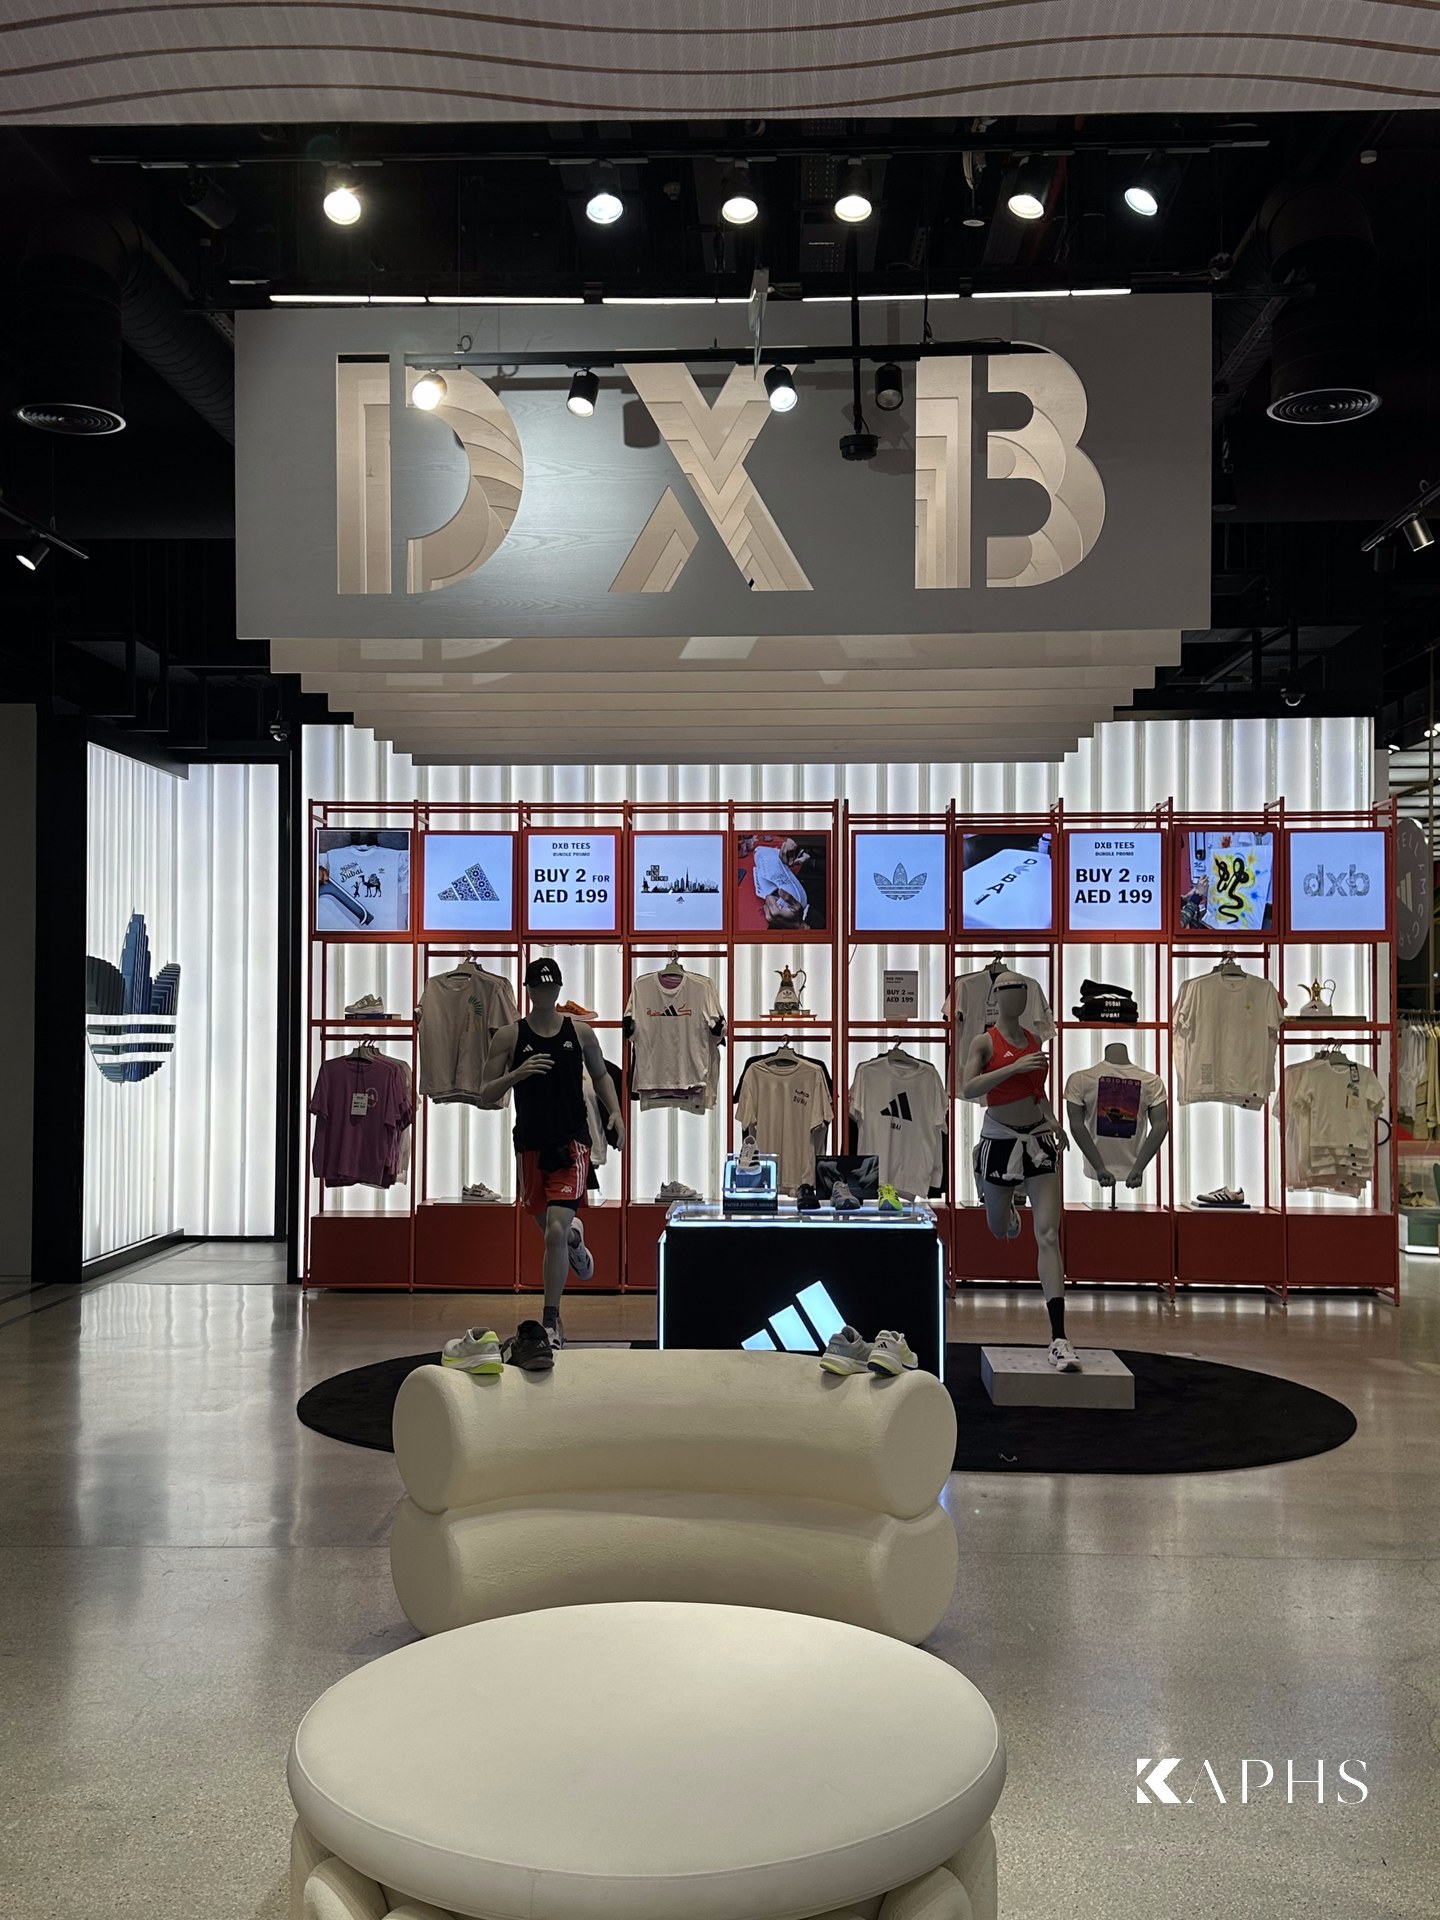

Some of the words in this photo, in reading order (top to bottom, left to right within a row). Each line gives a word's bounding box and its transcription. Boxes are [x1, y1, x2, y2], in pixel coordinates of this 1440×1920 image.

[336, 343, 1107, 595] DXB
[552, 842, 569, 850] DXB
[571, 842, 591, 850] TEES
[1094, 841, 1112, 849] DXB
[1114, 841, 1135, 849] TEES
[534, 868, 569, 883] BUY
[575, 868, 587, 883] 2
[592, 874, 610, 883] FOR
[1075, 868, 1113, 883] BUY
[1118, 868, 1130, 883] 2
[1136, 874, 1155, 883] FOR
[1303, 864, 1370, 897] dxb
[533, 889, 568, 903] AED
[575, 889, 608, 903] 199
[1074, 889, 1111, 904] AED
[1118, 889, 1152, 904] 199
